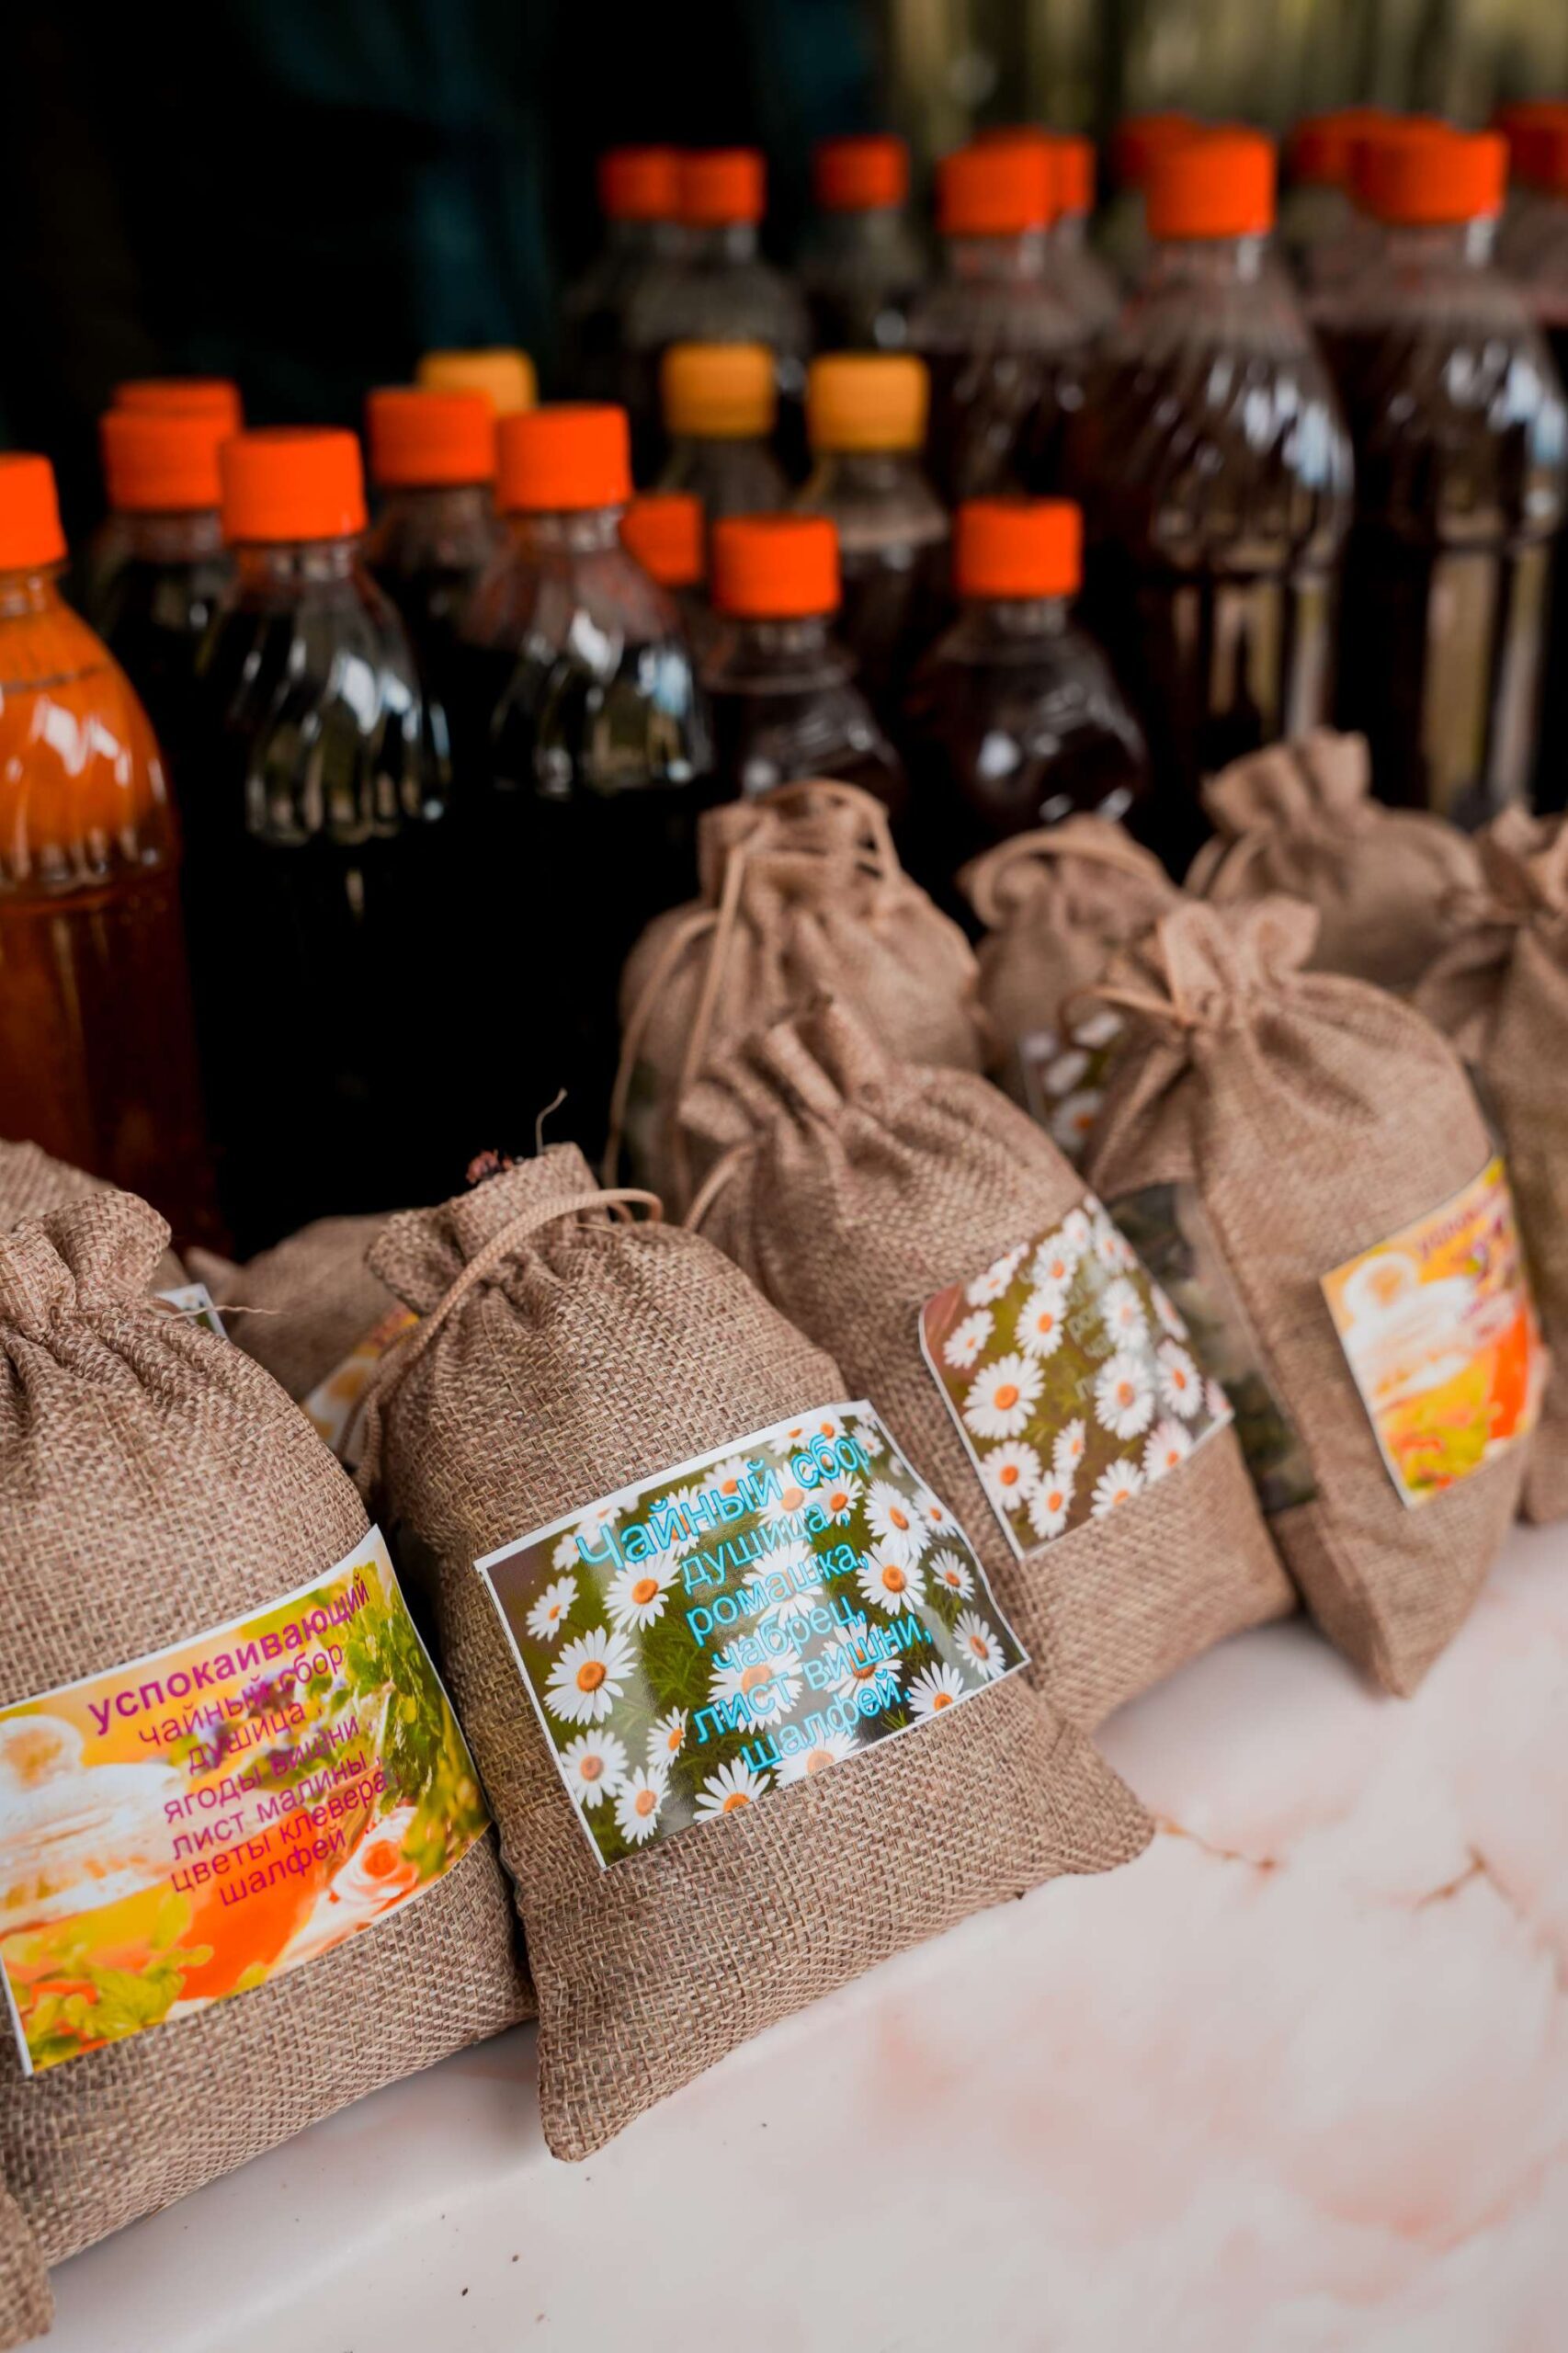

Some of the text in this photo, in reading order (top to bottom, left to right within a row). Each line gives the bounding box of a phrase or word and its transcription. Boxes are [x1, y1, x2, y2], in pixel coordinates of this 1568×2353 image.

[574, 1457, 783, 1568] Чайный
[685, 1541, 870, 1648] ромашка,
[710, 1595, 867, 1675] чабрец,
[86, 1572, 371, 1736] успокаивающий
[138, 1643, 344, 1747] чайный сбор
[691, 1612, 933, 1745] лист вишни,
[163, 1764, 263, 1825] ягоды
[170, 1810, 246, 1862] лист
[170, 1834, 273, 1895] цветы
